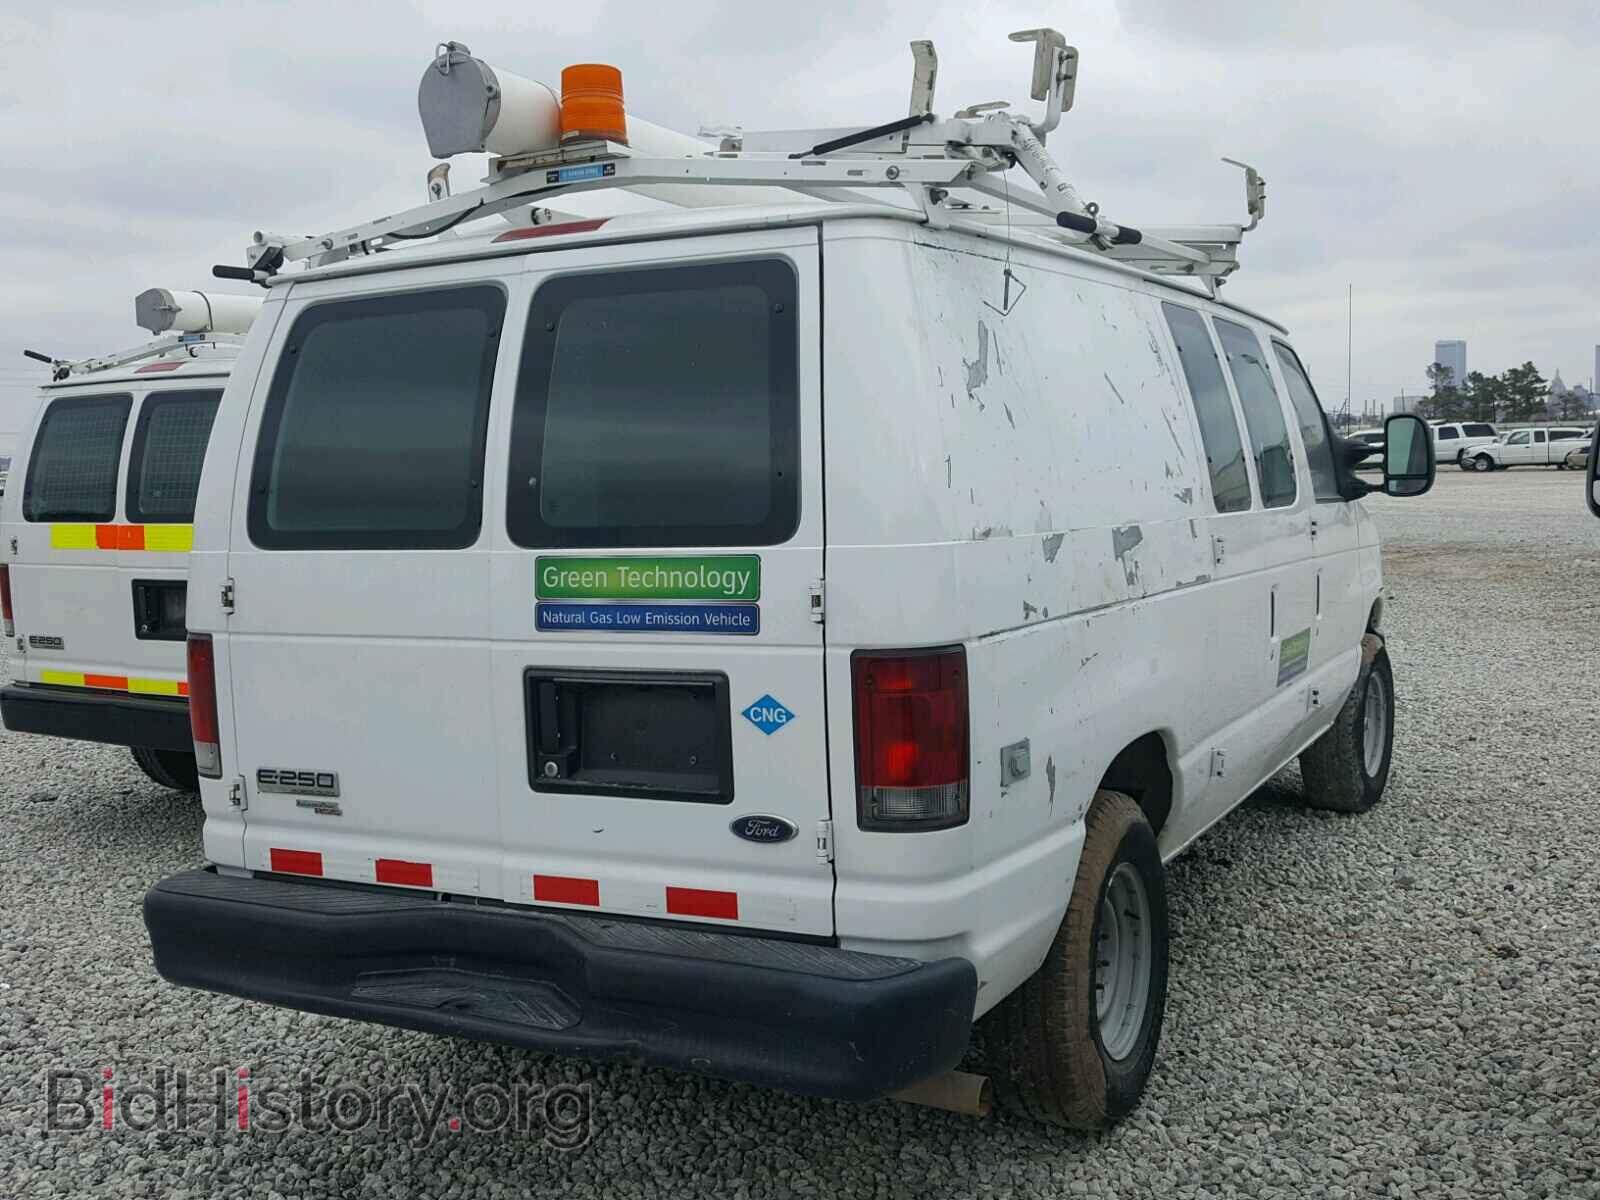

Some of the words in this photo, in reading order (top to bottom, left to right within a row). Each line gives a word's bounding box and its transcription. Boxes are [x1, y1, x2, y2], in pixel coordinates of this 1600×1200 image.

[543, 566, 608, 588] Green
[616, 565, 751, 595] Technology
[543, 611, 586, 624] Natural
[590, 611, 613, 624] Gas
[616, 611, 641, 625] Low
[645, 612, 700, 625] Emission
[704, 612, 751, 626] Vehicle
[749, 707, 787, 723] CNG
[744, 819, 781, 837] Ford
